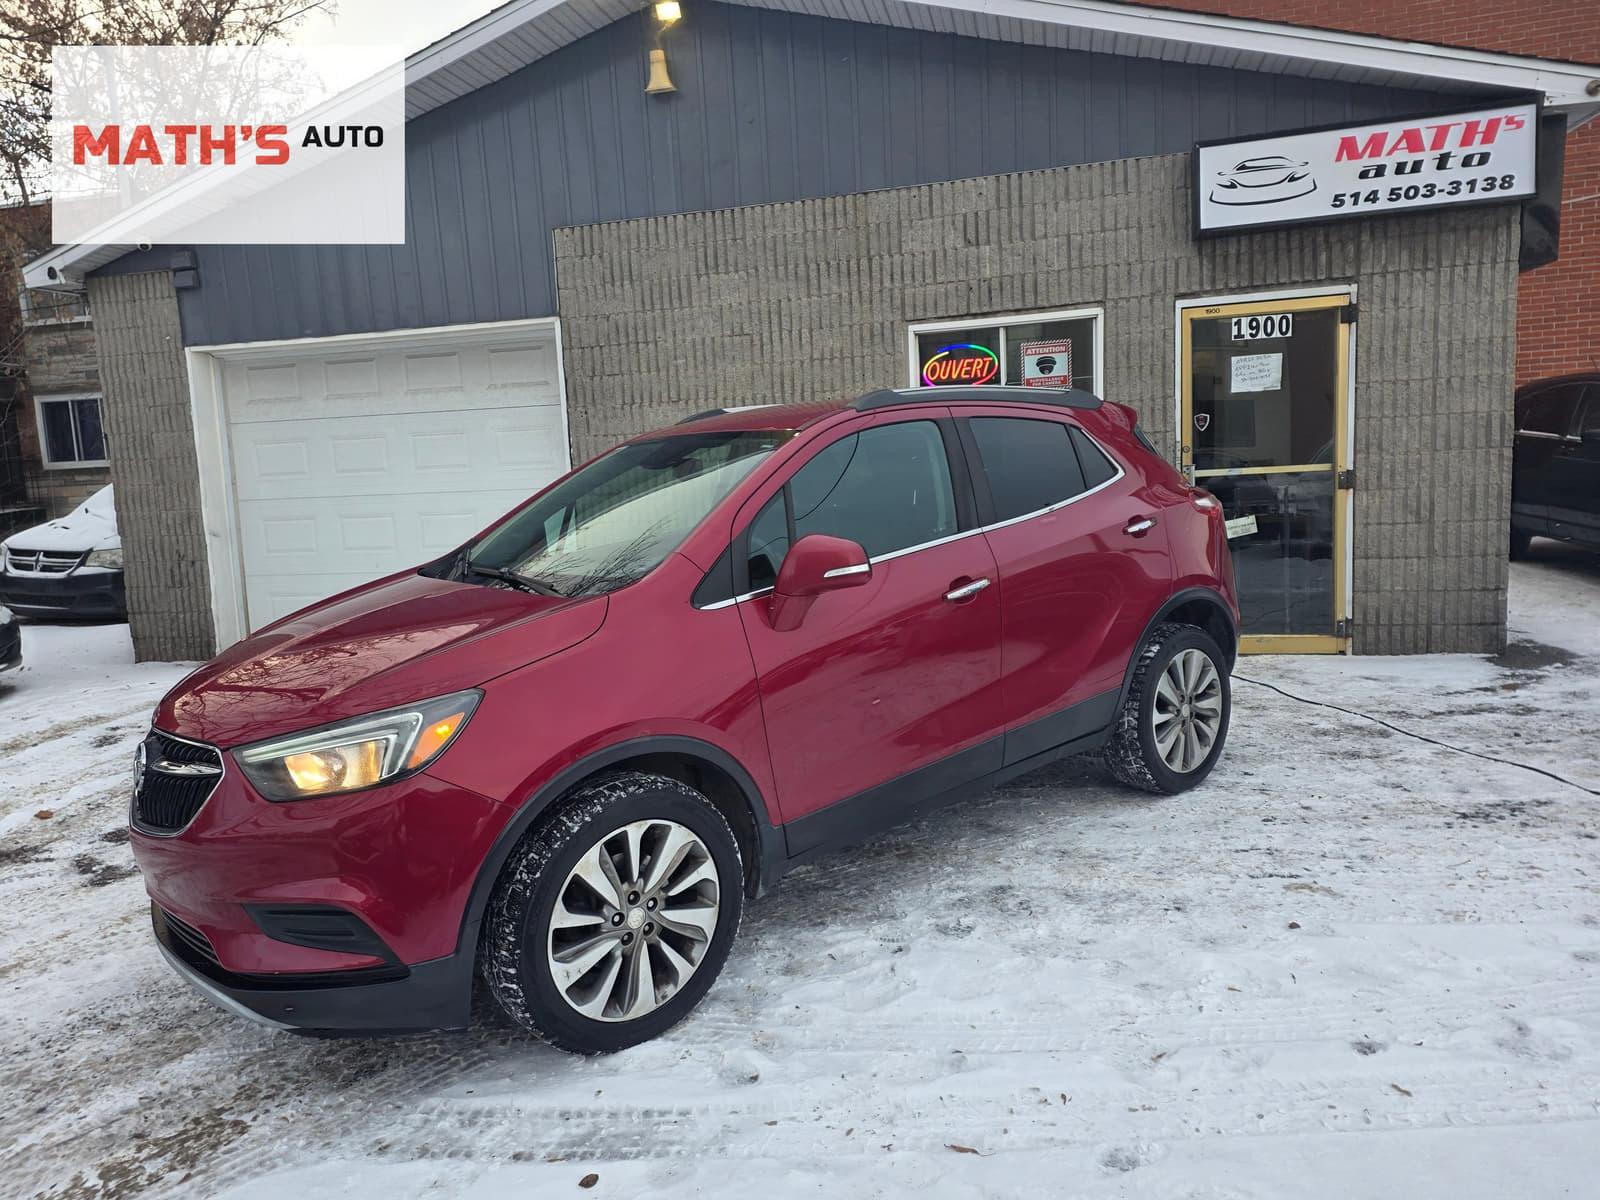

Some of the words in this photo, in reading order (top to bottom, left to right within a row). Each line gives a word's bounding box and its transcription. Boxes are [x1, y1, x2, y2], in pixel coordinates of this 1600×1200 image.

[1358, 150, 1492, 180] auto
[1331, 187, 1380, 208] 514
[1387, 174, 1515, 202] 503-3138
[1233, 315, 1290, 339] 1900
[1026, 345, 1066, 355] ATTENTION
[926, 357, 993, 381] OUVERT
